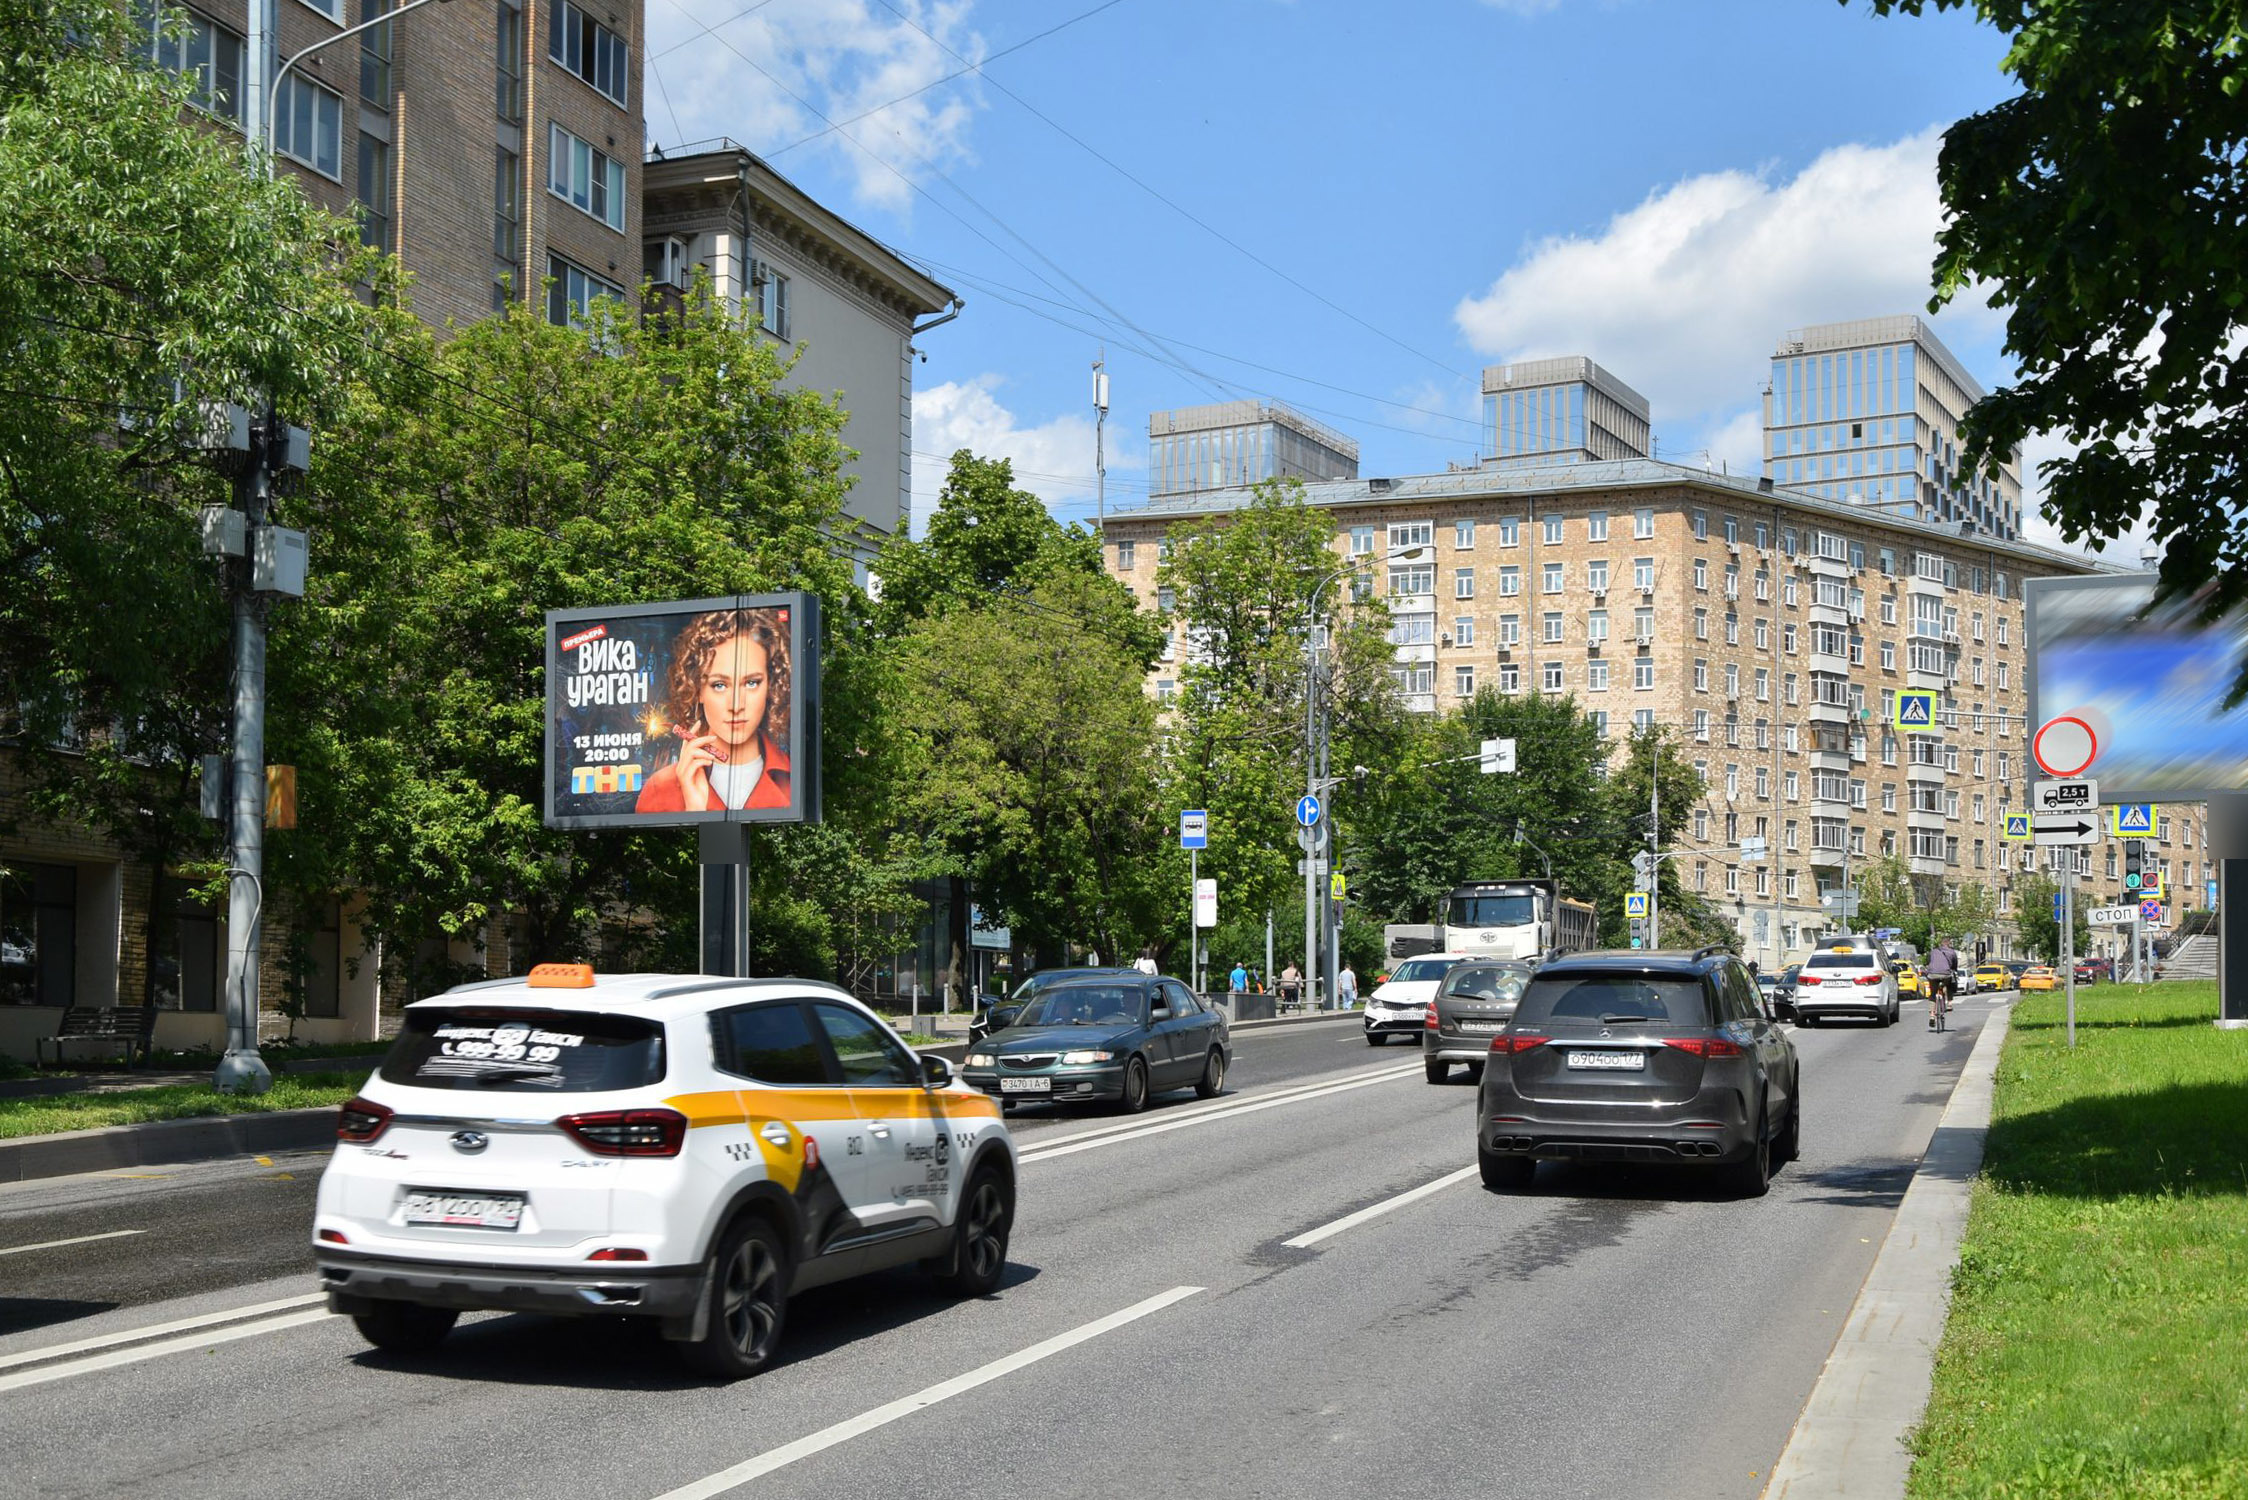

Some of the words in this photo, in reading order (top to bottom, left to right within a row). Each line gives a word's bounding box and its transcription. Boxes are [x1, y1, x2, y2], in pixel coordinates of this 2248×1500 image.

[573, 735, 590, 749] 13
[593, 732, 642, 747] ИЮНЯ
[584, 748, 630, 763] 20:00
[571, 764, 642, 794] ТНТ
[2062, 787, 2078, 797] 2,5
[2095, 908, 2132, 922] СТОП
